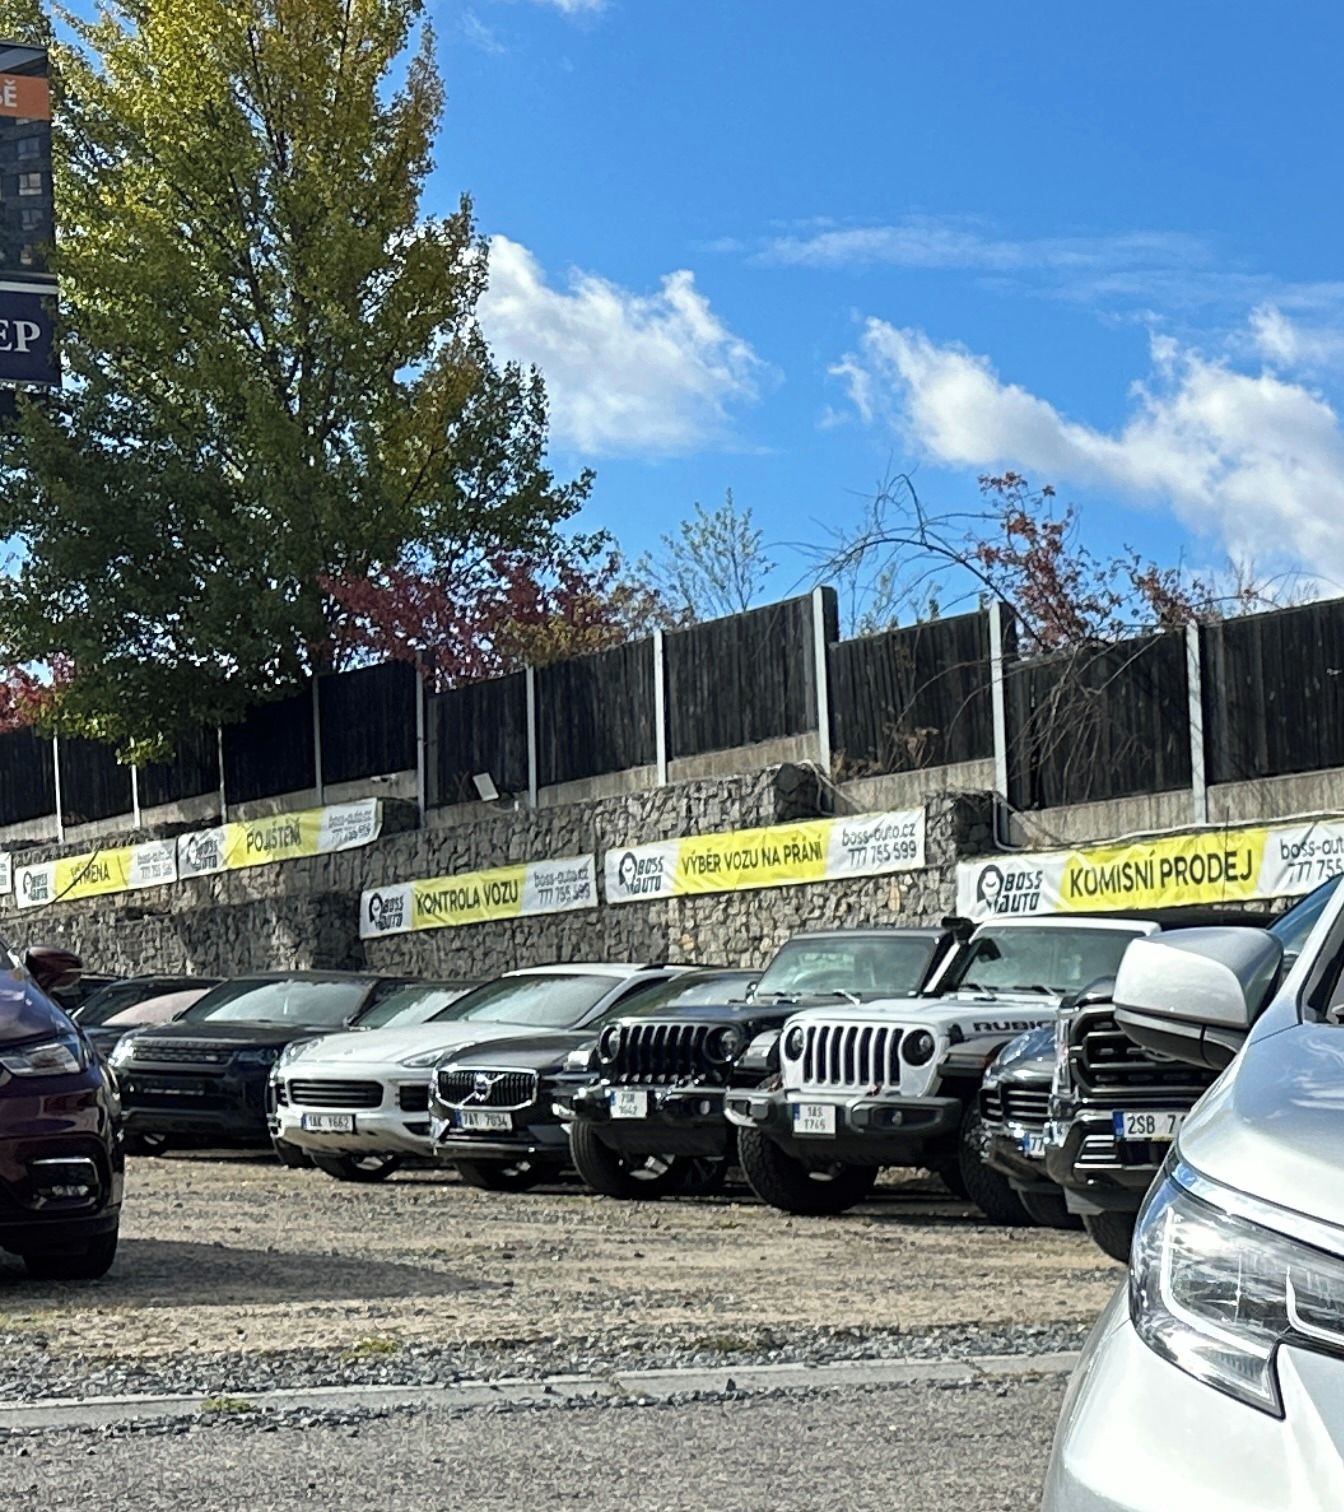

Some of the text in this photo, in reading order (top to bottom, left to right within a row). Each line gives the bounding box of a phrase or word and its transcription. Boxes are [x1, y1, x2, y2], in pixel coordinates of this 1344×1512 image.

[841, 823, 916, 847] boss-auto.cz
[681, 834, 823, 875] VÝBĚR VOZU NA PŘÁNÍ
[848, 840, 917, 866] 777 755 599
[637, 856, 664, 876] BOSS
[1070, 850, 1253, 898] KOMISNÍ PRODEJ
[633, 874, 662, 893] AUTO
[1004, 870, 1043, 891] BOSS
[415, 880, 519, 916] KONTROLA VOZU
[999, 892, 1040, 912] AUTO
[1127, 1115, 1156, 1134] 2SB
